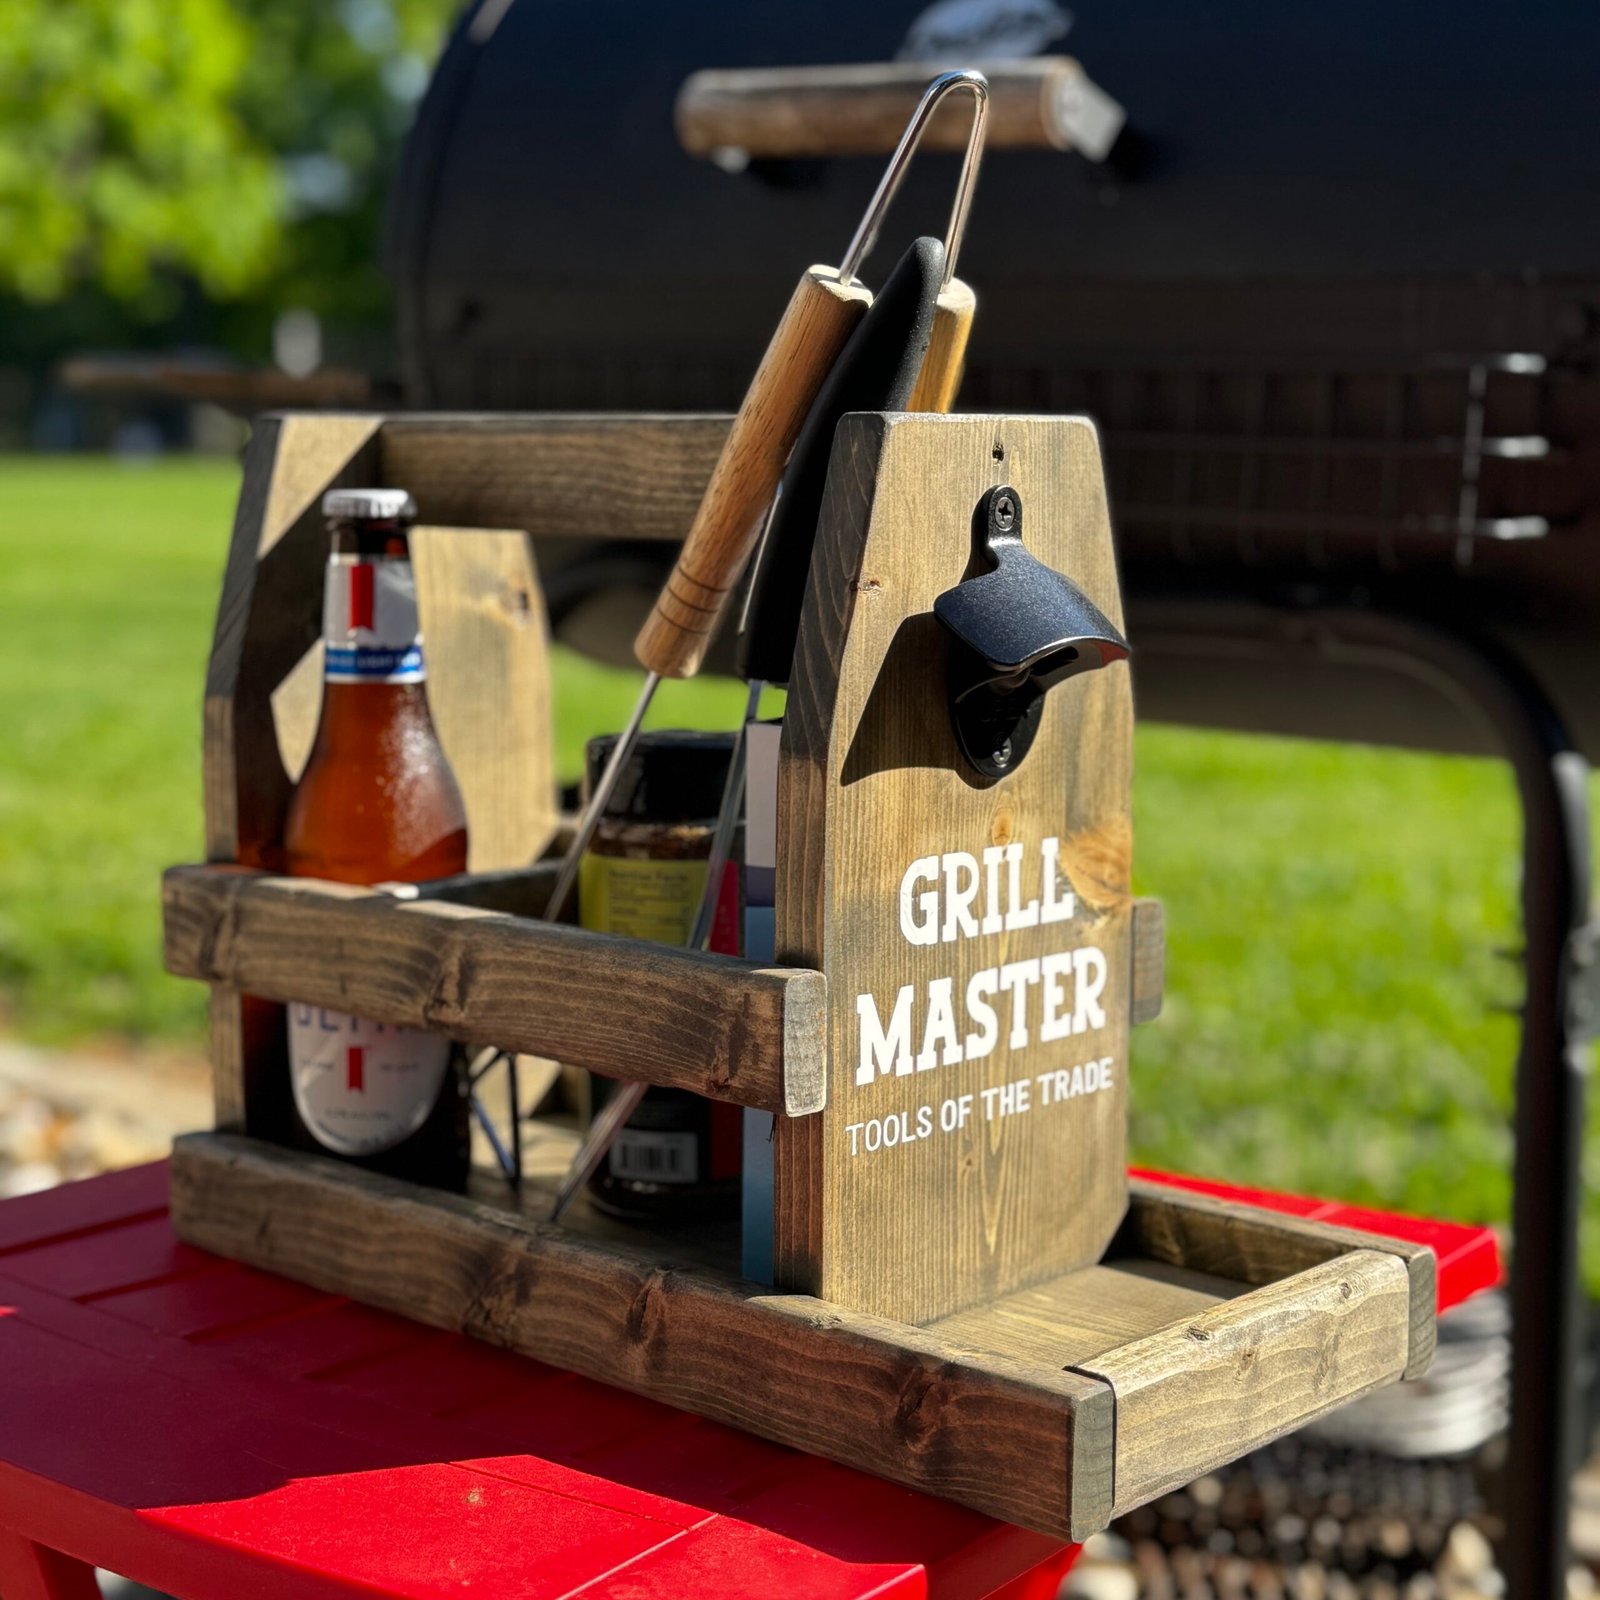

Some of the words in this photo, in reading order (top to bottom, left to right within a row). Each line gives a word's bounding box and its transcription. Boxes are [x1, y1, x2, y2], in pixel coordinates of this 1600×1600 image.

[899, 837, 1075, 946] GRILL
[856, 946, 1108, 1086] MASTER
[846, 1106, 933, 1156] TOOLS
[941, 1095, 973, 1132] OF
[981, 1079, 1031, 1121] THE
[1037, 1057, 1114, 1105] TRADE
